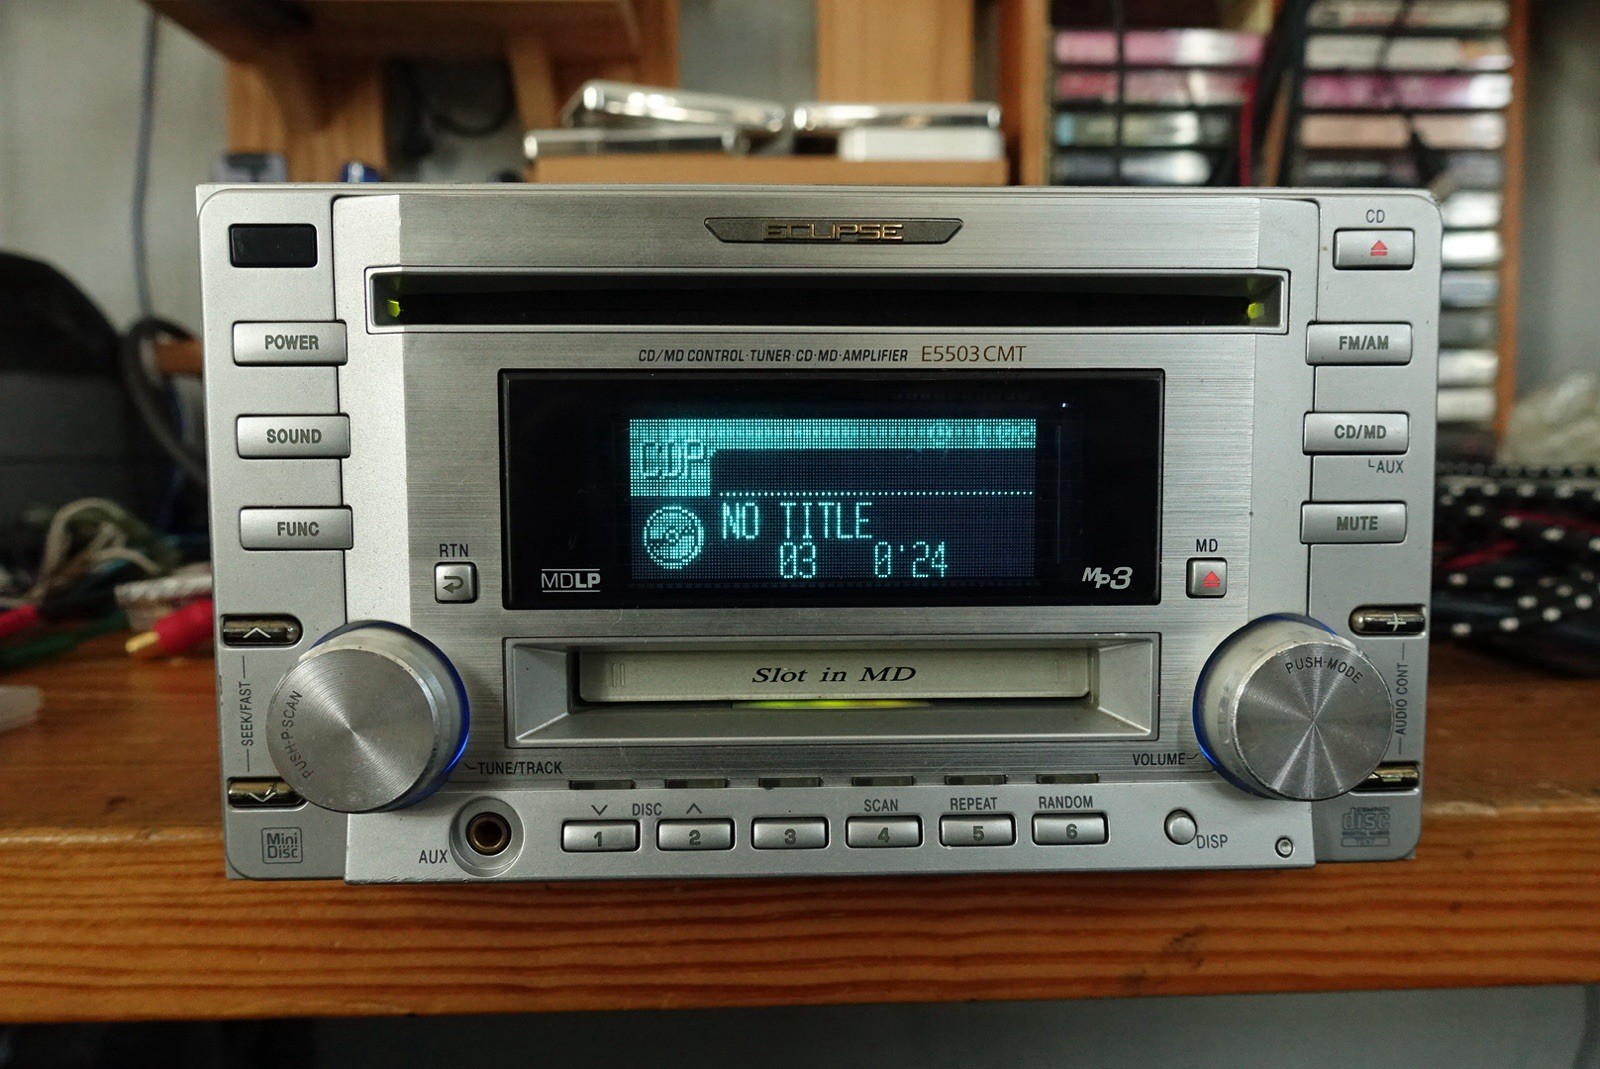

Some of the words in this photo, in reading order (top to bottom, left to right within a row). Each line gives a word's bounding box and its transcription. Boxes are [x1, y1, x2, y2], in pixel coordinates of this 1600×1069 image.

[1365, 209, 1386, 223] CD
[763, 223, 904, 241] ECLIPSE
[264, 334, 320, 351] POWER
[1339, 335, 1389, 351] FM/AM
[638, 349, 684, 362] CD/MD
[921, 345, 980, 363] E5503
[984, 345, 1027, 362] CMT
[266, 428, 323, 445] SOUND
[1334, 424, 1387, 440] CD/MD
[1376, 460, 1405, 474] AUX
[722, 502, 759, 539] NO
[780, 502, 872, 539] TITLE
[1336, 516, 1378, 532] MUTE
[276, 520, 320, 537] FUNC
[439, 543, 469, 558] RTN
[1195, 538, 1219, 553] MD
[780, 541, 816, 579] 03
[541, 573, 600, 588] MDLP
[752, 667, 808, 683] Slot
[819, 667, 848, 682] in
[858, 666, 917, 682] MD
[1396, 663, 1409, 691] CONT
[239, 680, 254, 747] SEEK/FAST
[1395, 694, 1408, 735] AUDIO
[1132, 753, 1186, 766] VOLUME
[477, 761, 563, 775] TUNE/TRACK
[632, 803, 662, 816] DISC
[864, 799, 898, 812] SCAN
[950, 797, 997, 810] REPEAT
[1038, 795, 1093, 809] RANDOM
[266, 832, 298, 845] Mini
[688, 830, 701, 845] 2
[784, 829, 797, 845] 3
[877, 827, 891, 843] 4
[972, 826, 985, 841] 5
[1065, 823, 1078, 839] 6
[593, 832, 603, 847] 1
[1196, 834, 1228, 848] DISP
[267, 845, 298, 859] Disc
[418, 851, 448, 864] AUX
